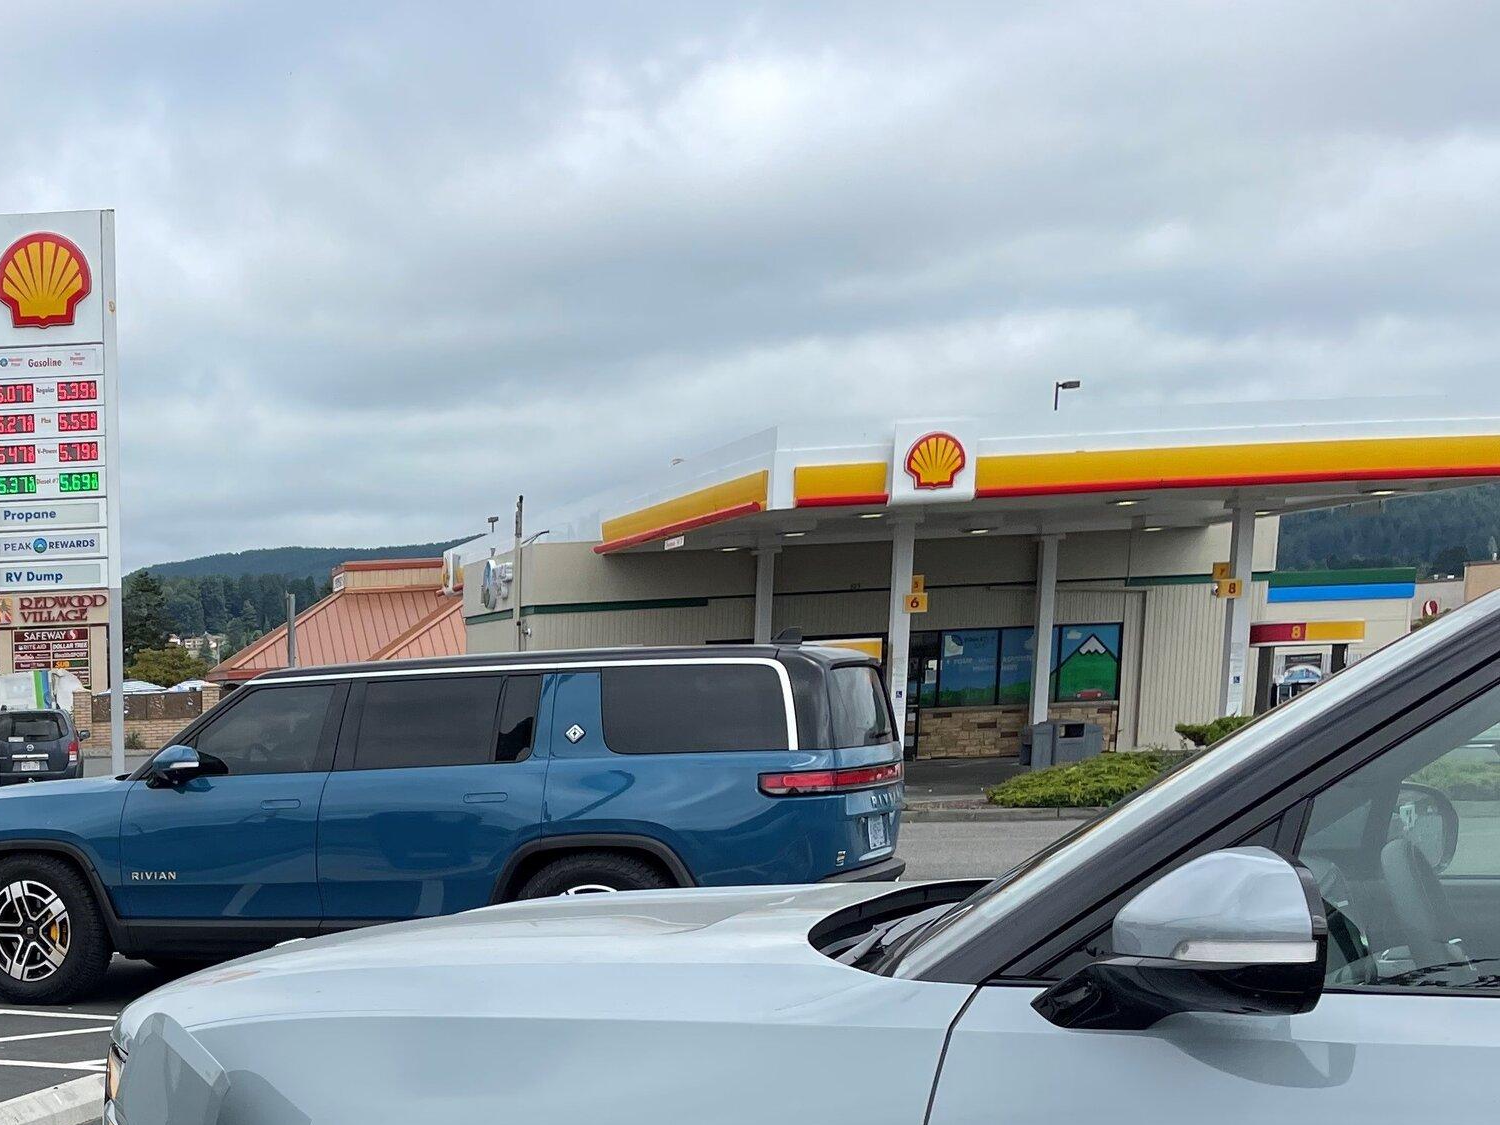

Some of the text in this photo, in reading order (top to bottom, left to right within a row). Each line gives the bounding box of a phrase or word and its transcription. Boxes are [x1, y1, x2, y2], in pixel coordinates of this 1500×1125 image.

[28, 357, 62, 368] Gasoline
[36, 387, 55, 395] Regular
[3, 510, 56, 522] Propane
[3, 539, 95, 551] PEAK REWARDS
[5, 571, 63, 583] RV Dump
[1228, 582, 1236, 594] 8
[19, 594, 107, 610] REDWOOD
[910, 597, 919, 608] 6
[20, 608, 88, 623] VILLAGE
[24, 630, 66, 641] SAFEWAY
[1291, 625, 1301, 640] 8
[52, 642, 74, 650] DOLLAR
[131, 871, 177, 881] RIVIAN
